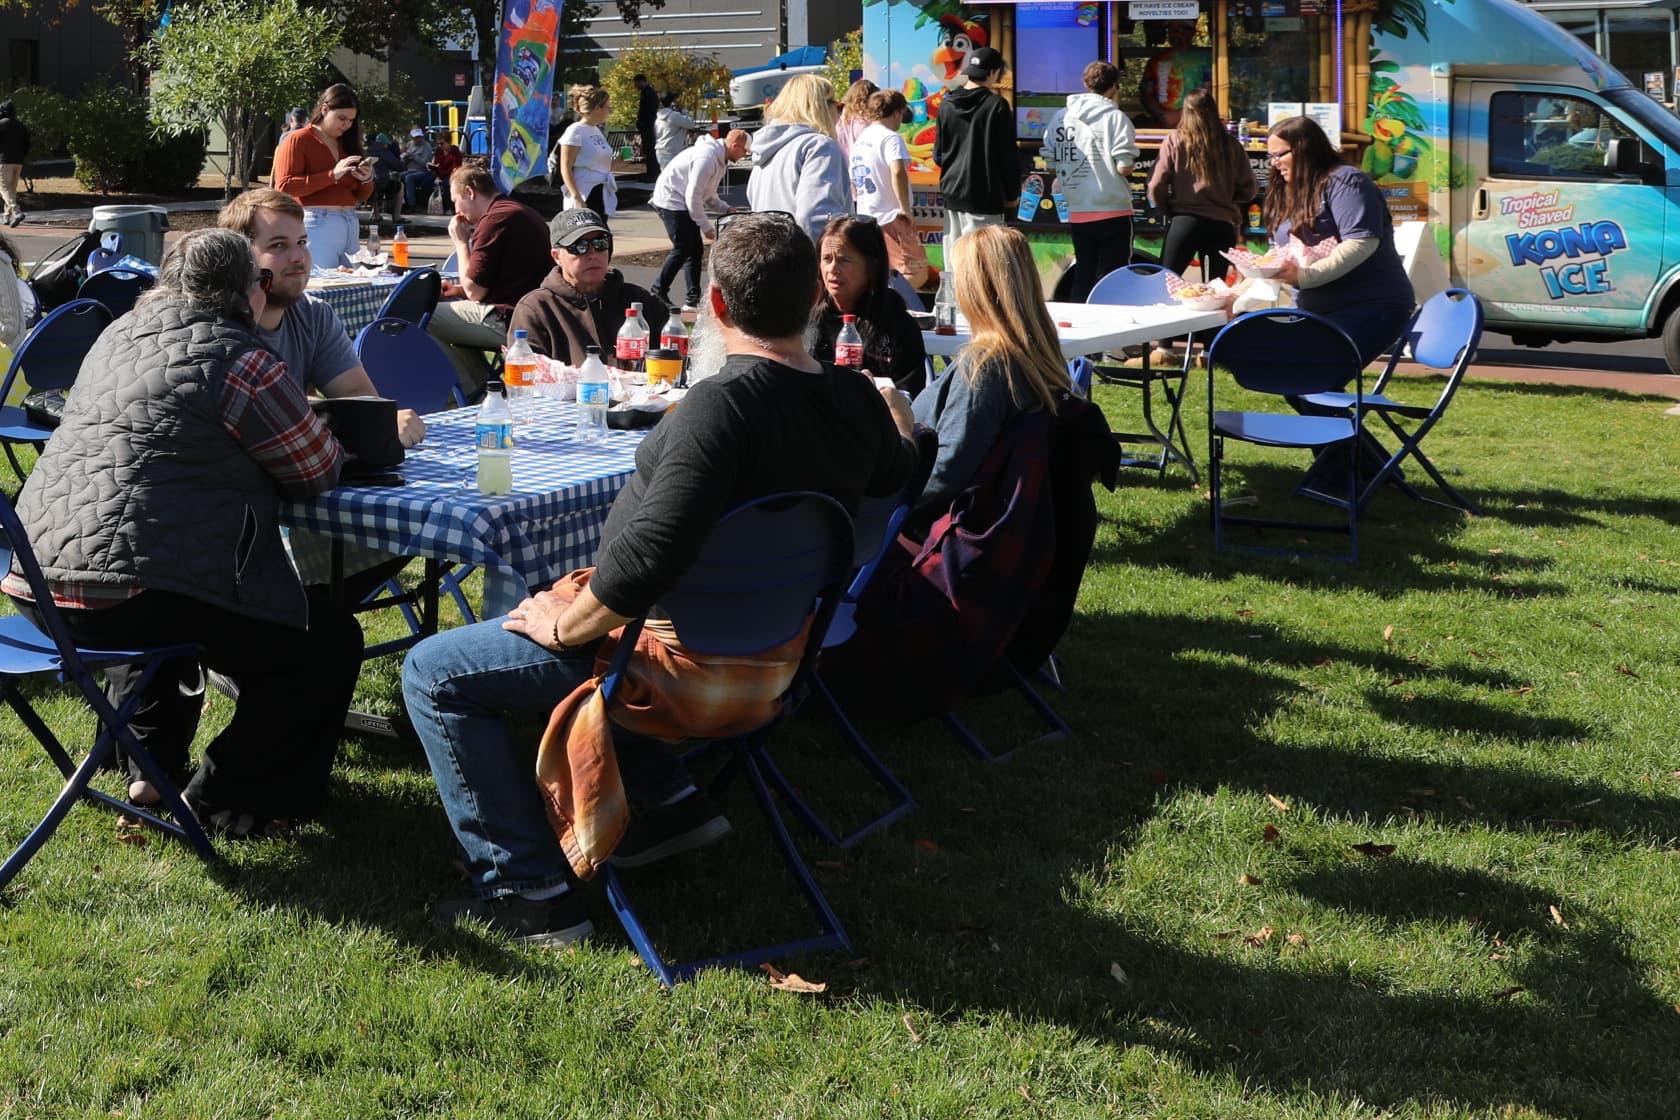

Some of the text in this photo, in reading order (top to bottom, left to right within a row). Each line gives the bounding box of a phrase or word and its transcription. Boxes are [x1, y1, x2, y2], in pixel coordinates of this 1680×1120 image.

[1055, 126, 1076, 142] SC
[1054, 146, 1078, 162] LIFE
[1501, 190, 1559, 214] Tropical
[1519, 205, 1574, 228] Shaved
[1505, 220, 1628, 267] KONA
[1539, 258, 1612, 300] ICE
